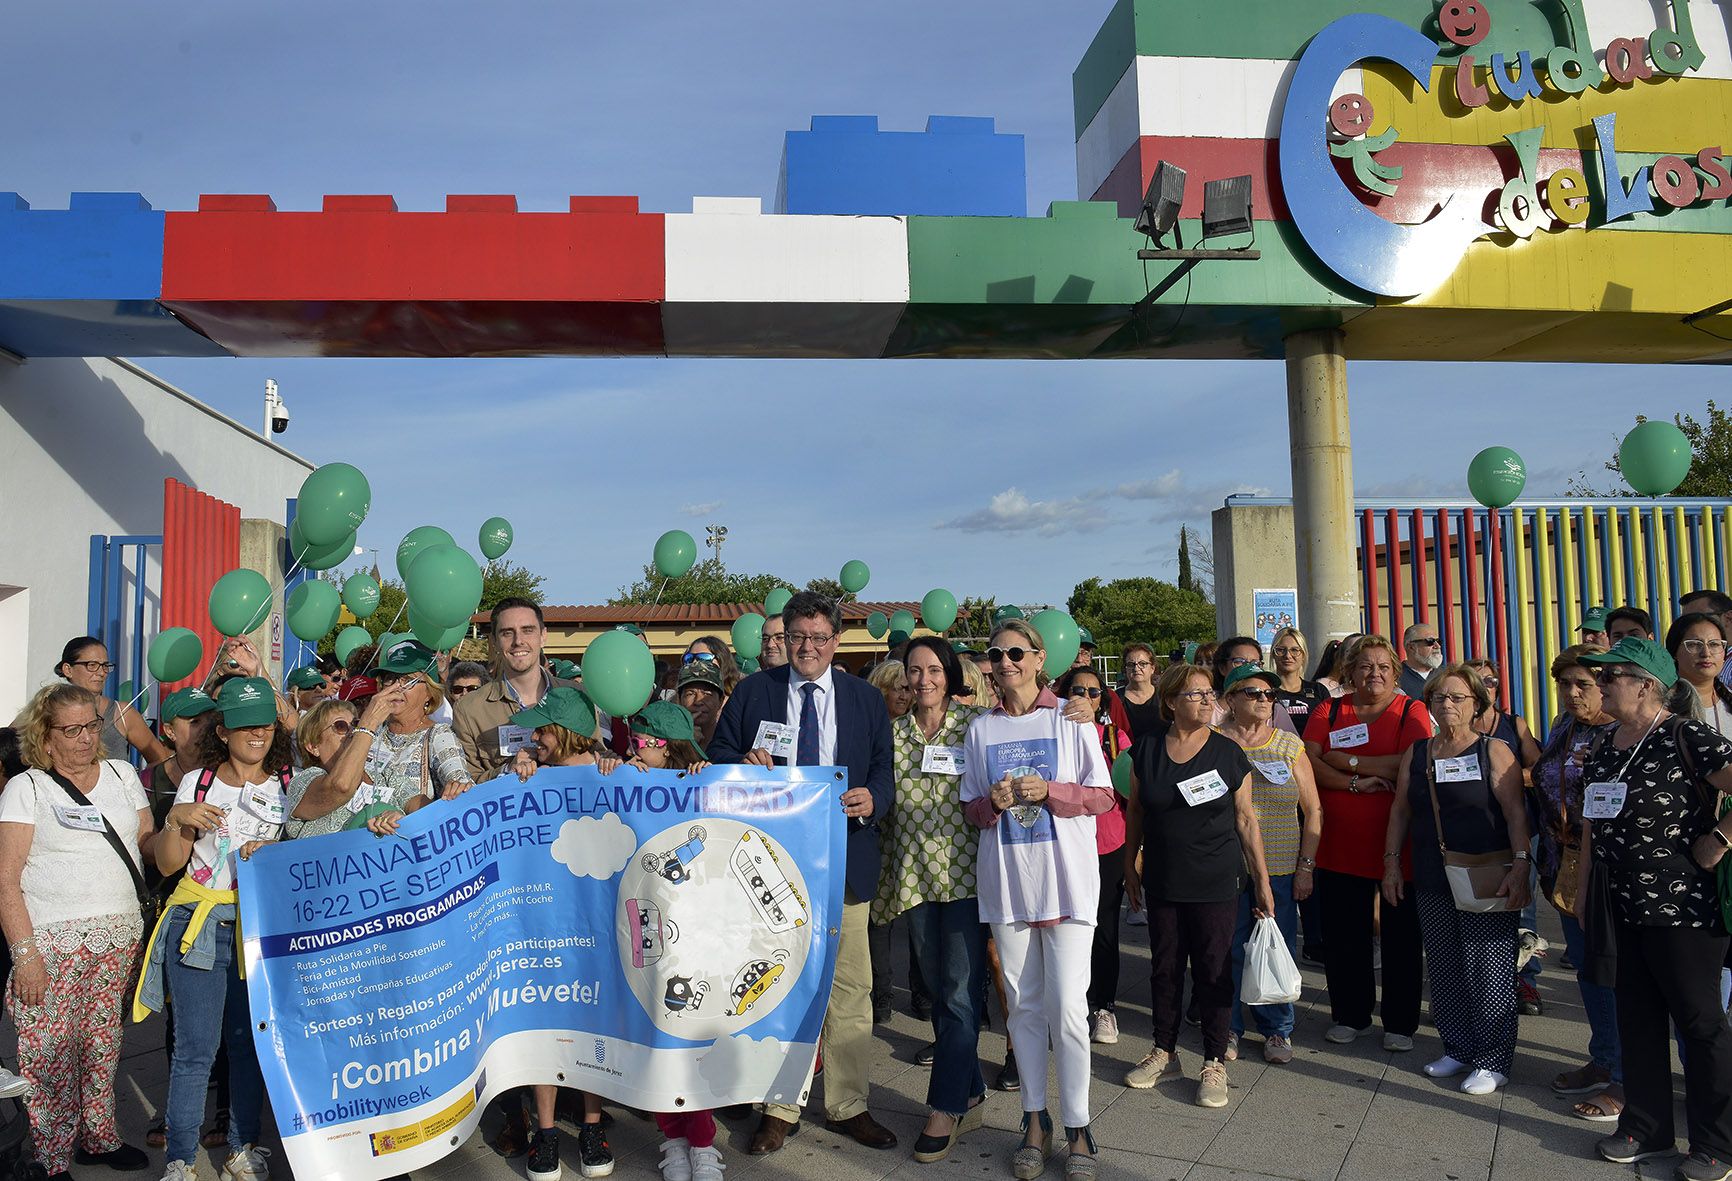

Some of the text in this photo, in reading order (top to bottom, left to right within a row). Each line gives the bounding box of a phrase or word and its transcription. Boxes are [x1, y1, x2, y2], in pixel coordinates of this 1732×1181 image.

[1500, 126, 1590, 239] de
[293, 824, 553, 923] 16-22 DE SEPTIEMBRE
[485, 885, 525, 905] Culturales
[526, 883, 554, 893] P.M.R.
[289, 875, 486, 951] ACTIVIDADES PROGRAMADAS:
[470, 923, 479, 932] La
[497, 900, 510, 910] Sin
[511, 896, 524, 905] Mi
[526, 894, 553, 904] Coche
[296, 961, 318, 971] Ruta
[320, 948, 362, 965] Solidaria
[373, 943, 388, 952] Pie
[299, 939, 446, 983] Feria de la Movilidad Sostenible
[303, 973, 362, 995] Bici-Amistad
[304, 1014, 363, 1039] ¡Sorteos
[367, 1011, 375, 1026] y
[377, 996, 435, 1020] Regalos
[437, 980, 465, 1005] para
[488, 945, 502, 962] los
[506, 936, 596, 954] participantes!
[306, 960, 453, 1007] Jornadas y Campañas Educativas
[331, 979, 600, 1100] ¡Combina y Muévete!
[349, 1033, 377, 1048] Más
[381, 1001, 465, 1043] información:
[292, 1084, 432, 1131] #mobilityweek
